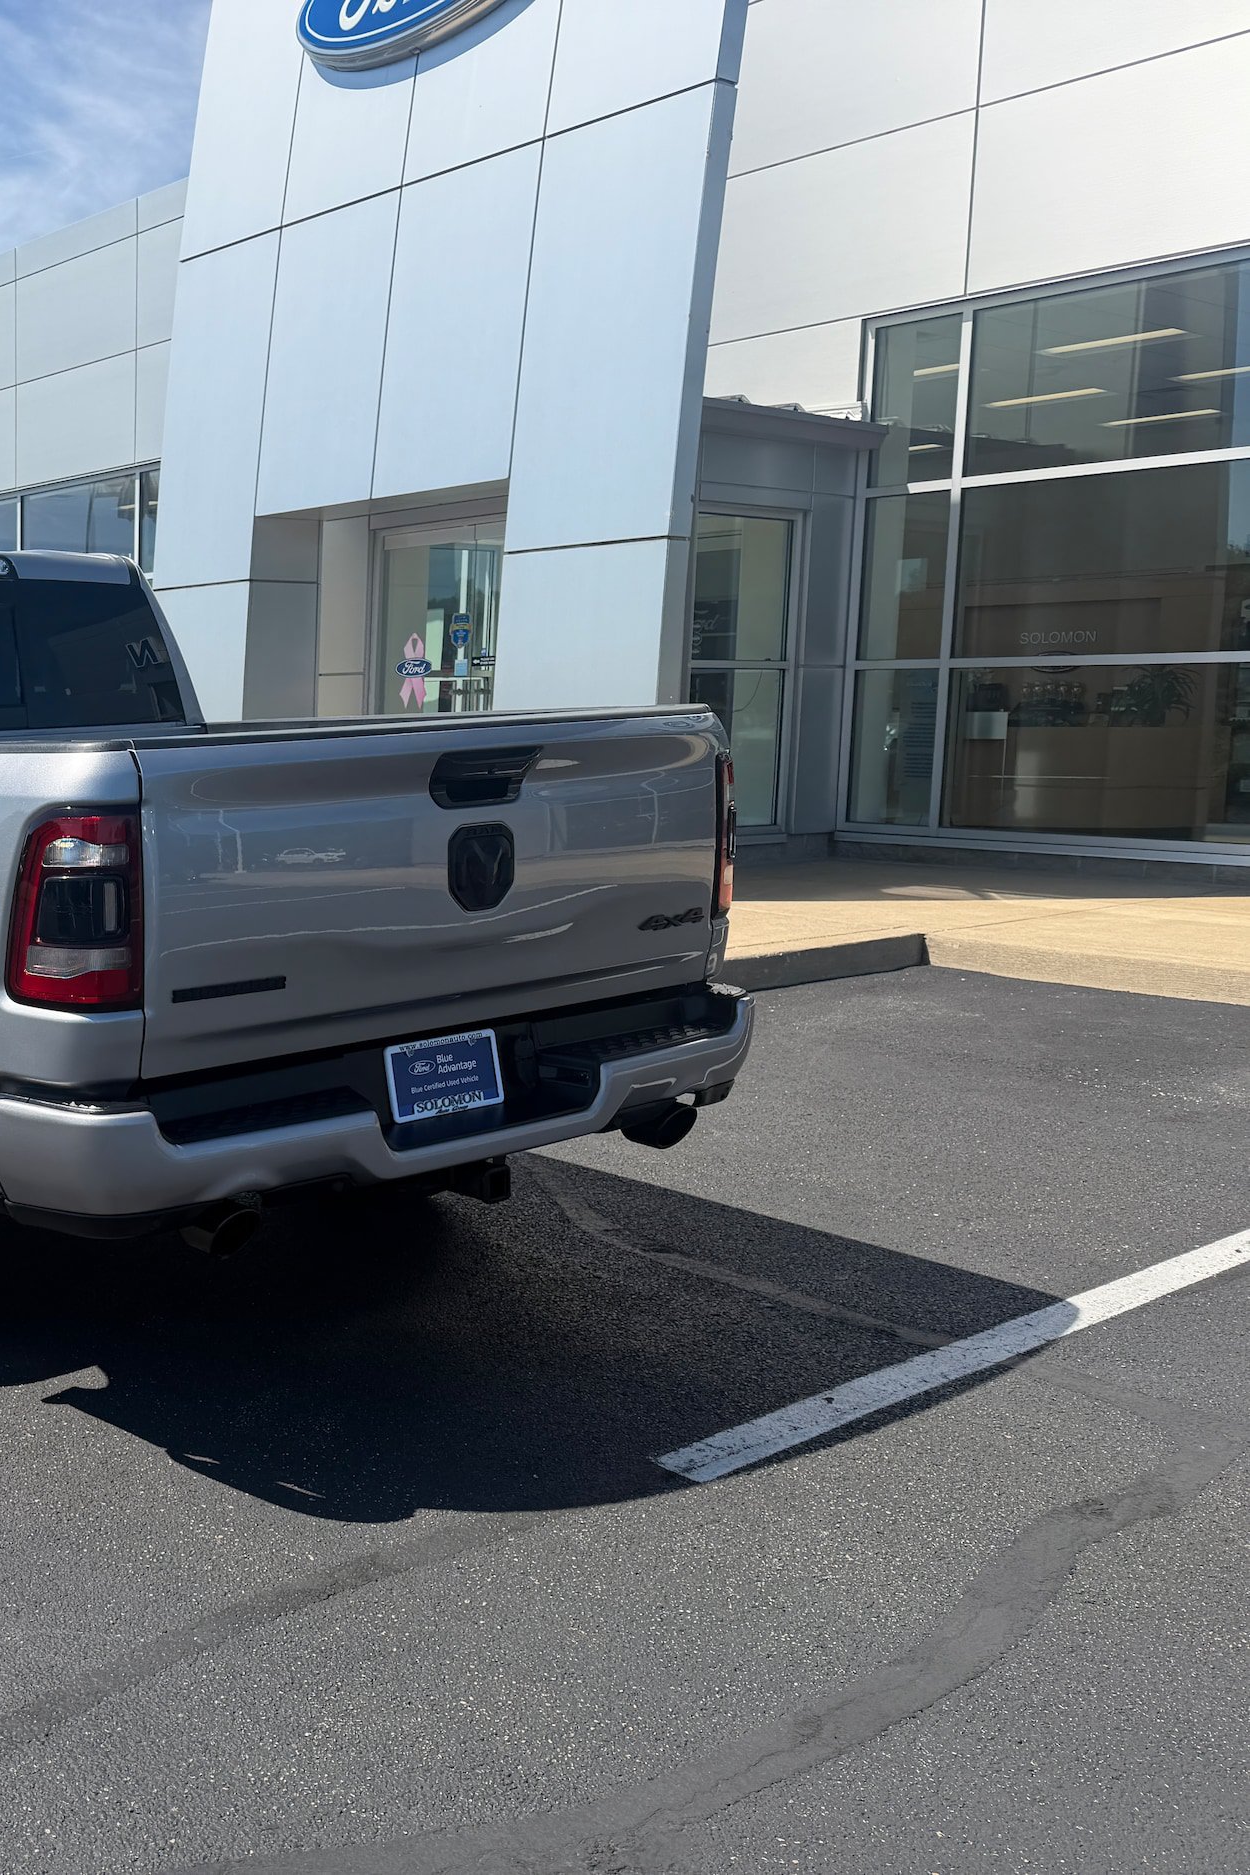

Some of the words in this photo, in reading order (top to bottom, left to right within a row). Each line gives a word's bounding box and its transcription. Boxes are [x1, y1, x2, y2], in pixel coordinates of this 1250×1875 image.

[1020, 630, 1098, 645] SOLOMON
[402, 661, 426, 674] Ford
[398, 1032, 483, 1052] www.solomonauto.com
[436, 1053, 453, 1064] Blue
[413, 1062, 431, 1073] Ford
[437, 1059, 477, 1074] Advantage
[411, 1086, 424, 1094] Blue
[424, 1081, 446, 1091] Certified
[416, 1090, 483, 1114] SOLOMON
